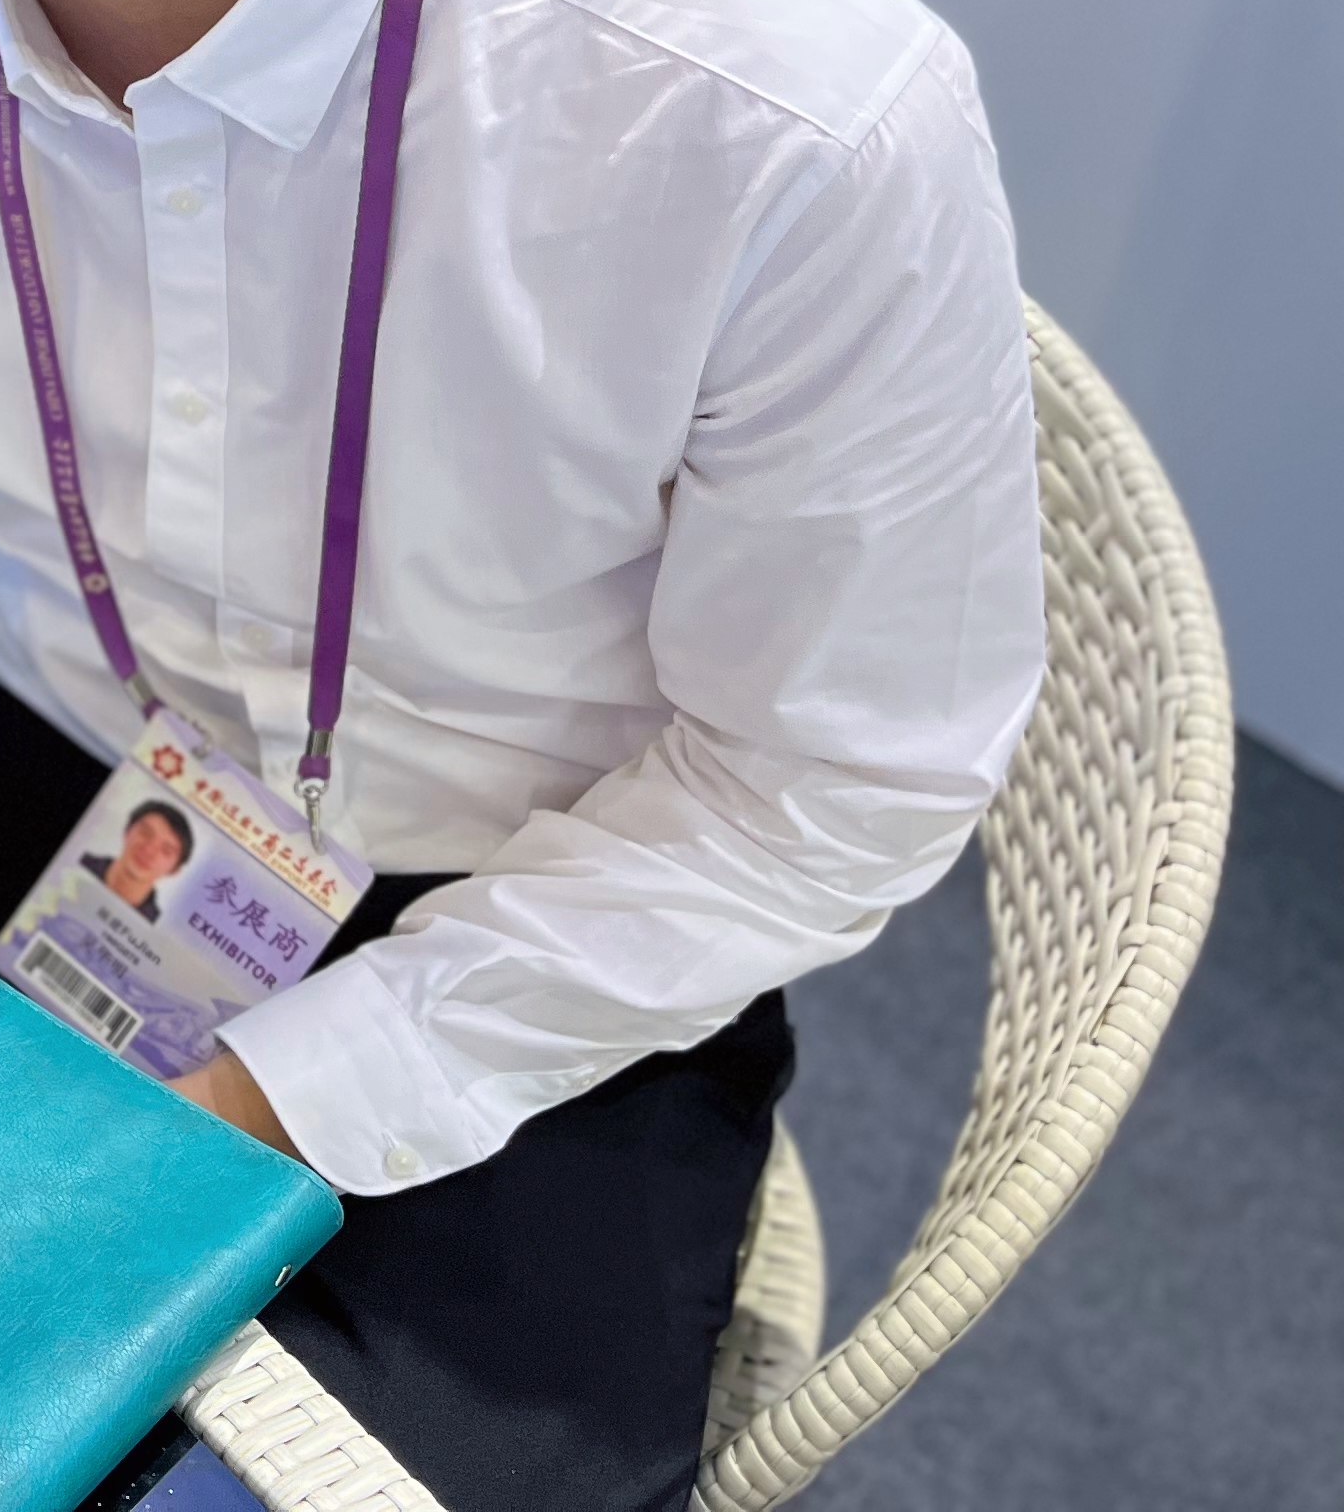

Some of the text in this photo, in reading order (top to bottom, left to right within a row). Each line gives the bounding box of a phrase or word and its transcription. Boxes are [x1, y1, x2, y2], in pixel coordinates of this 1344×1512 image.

[187, 912, 279, 990] EXHIBITOR
[203, 874, 308, 964] 参展商
